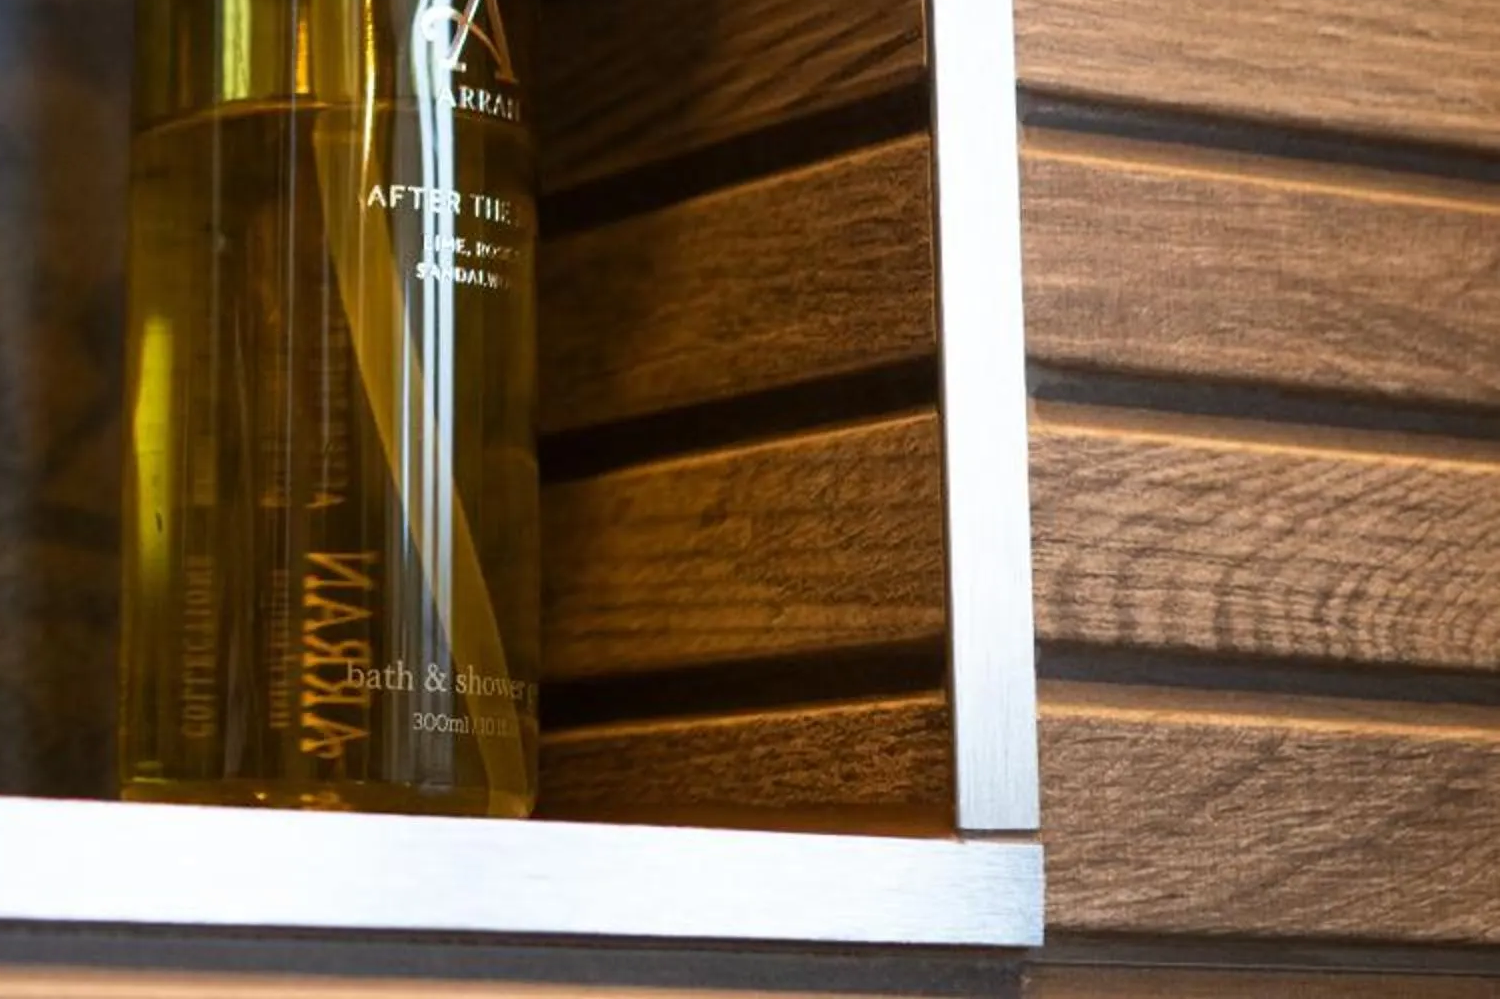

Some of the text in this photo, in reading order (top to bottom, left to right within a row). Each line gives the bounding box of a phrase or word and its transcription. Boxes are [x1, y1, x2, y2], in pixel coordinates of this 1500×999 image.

[367, 184, 462, 215] AFTER
[470, 193, 512, 225] THE
[346, 659, 414, 692] bath
[424, 664, 448, 693] &
[455, 665, 525, 700] shower
